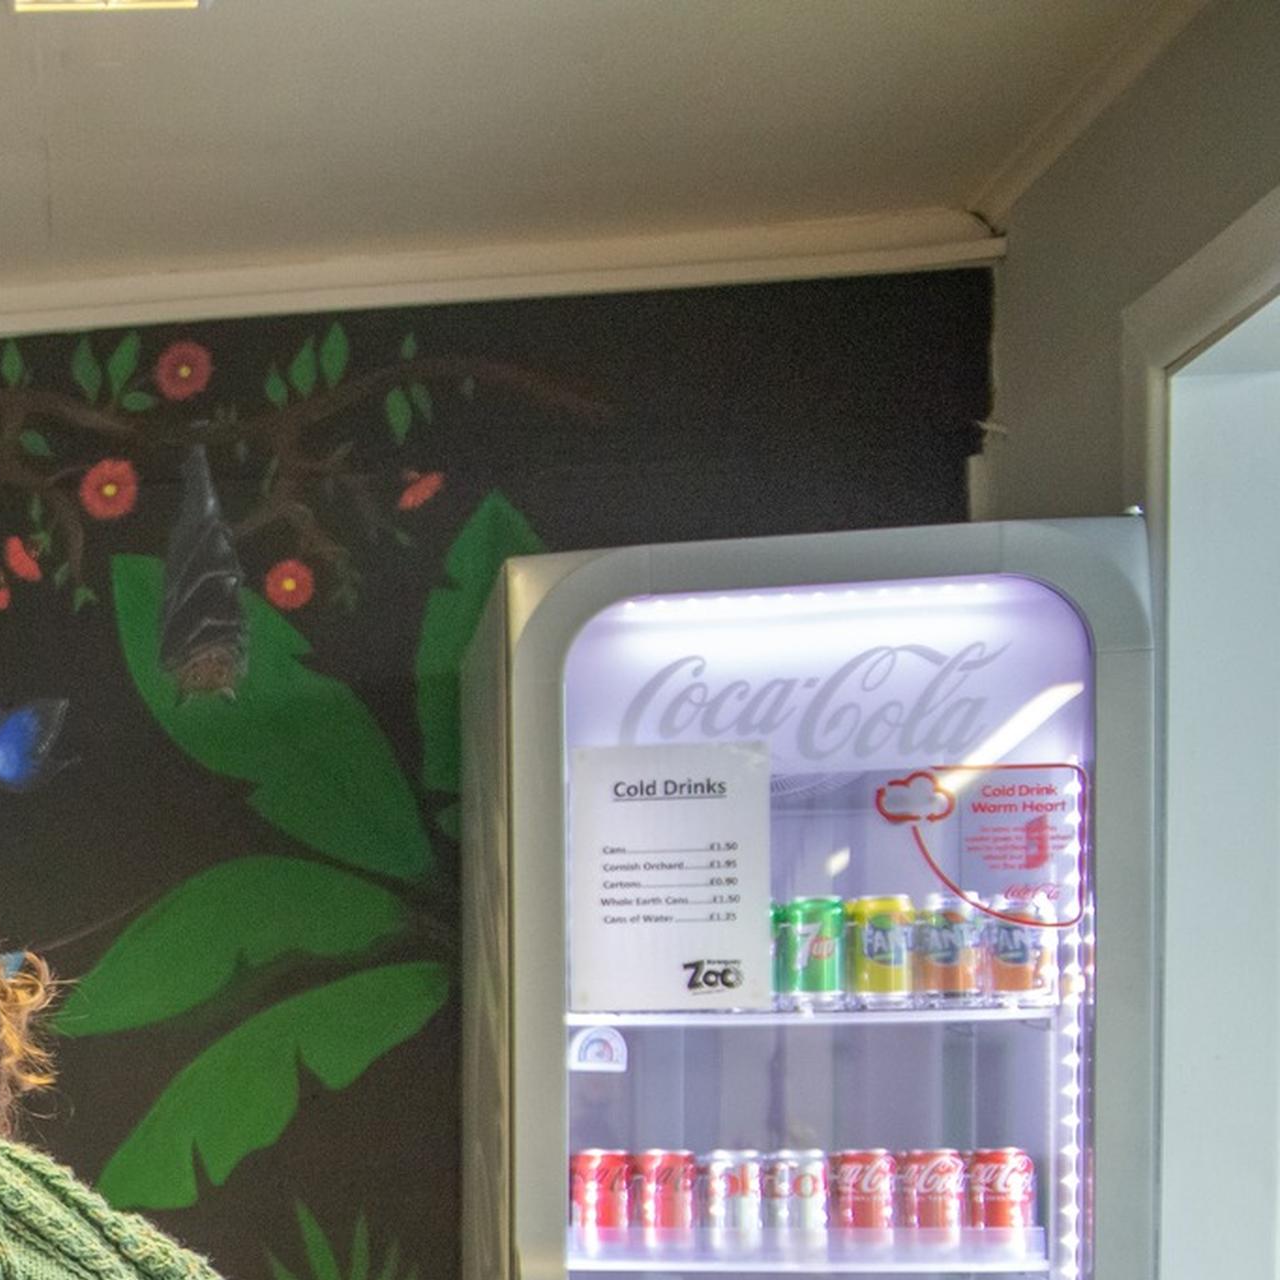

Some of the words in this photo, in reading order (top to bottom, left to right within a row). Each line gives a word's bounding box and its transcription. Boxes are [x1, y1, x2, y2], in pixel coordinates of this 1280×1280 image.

[619, 641, 1011, 761] Coca-Cola
[614, 780, 657, 798] Cold
[664, 778, 727, 796] Drinks
[981, 785, 1015, 797] Cold
[1018, 784, 1057, 797] Drink
[971, 802, 1018, 813] Warm
[1022, 800, 1067, 813] Heart
[643, 861, 685, 871] Orchard
[683, 960, 744, 991] Zoo
